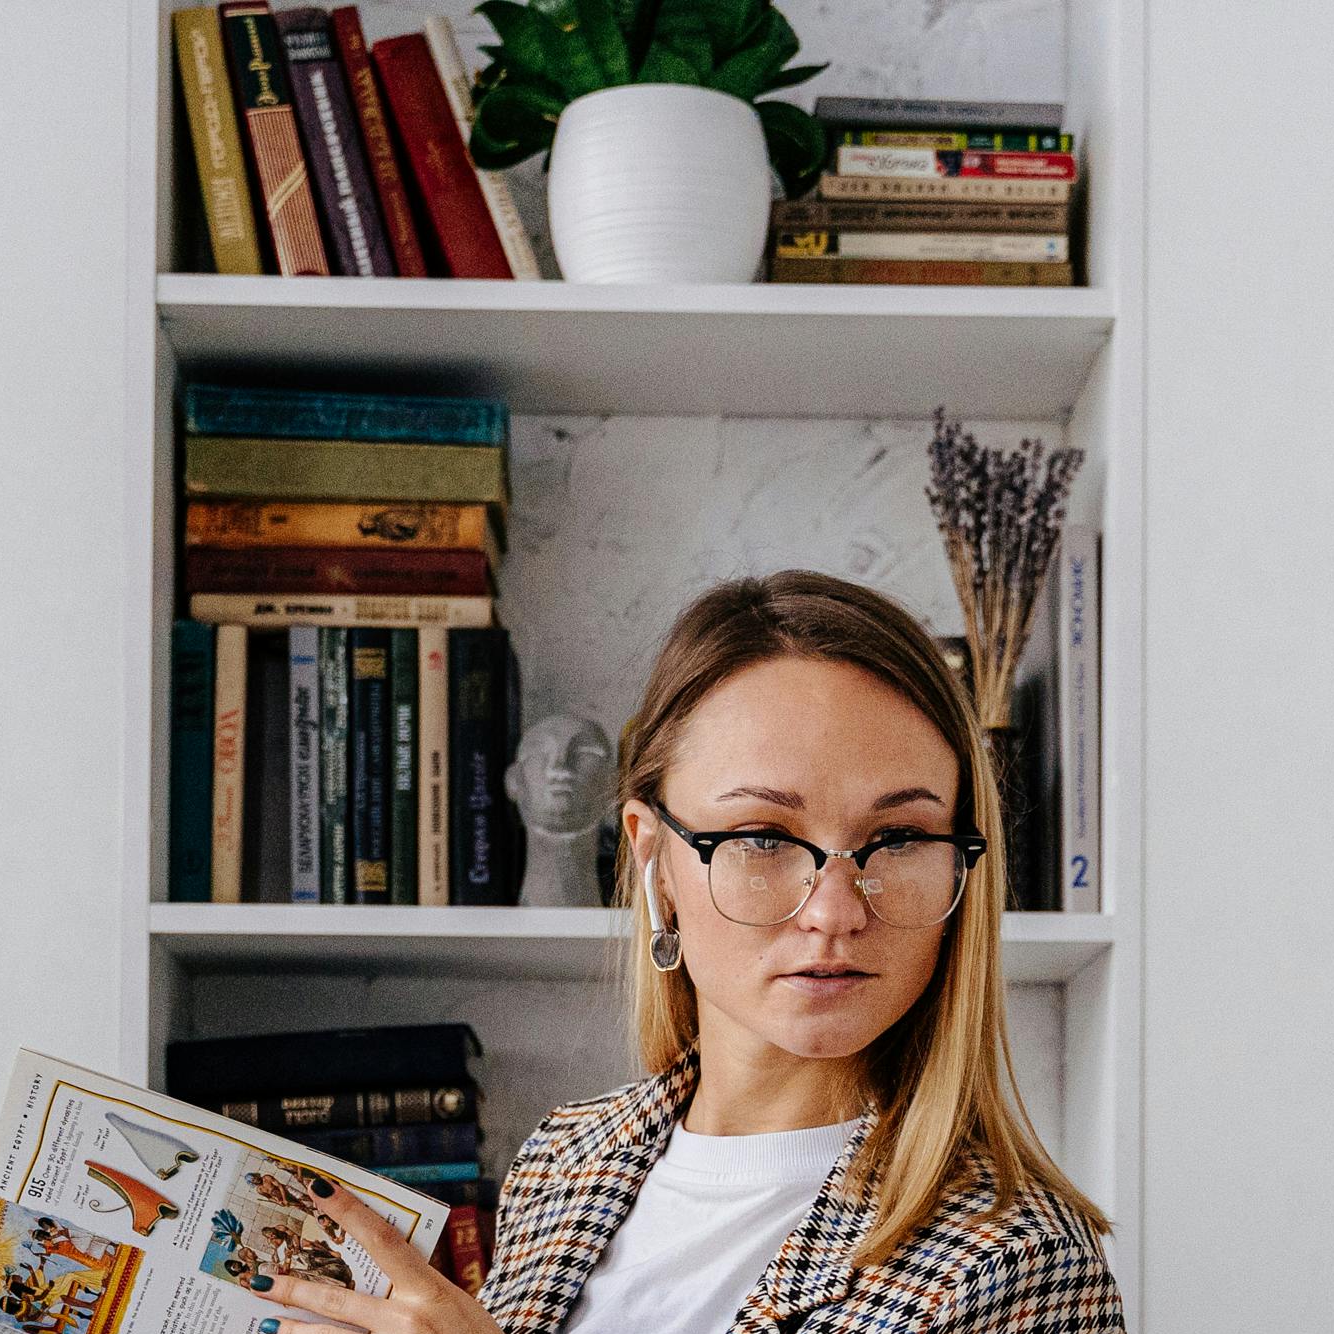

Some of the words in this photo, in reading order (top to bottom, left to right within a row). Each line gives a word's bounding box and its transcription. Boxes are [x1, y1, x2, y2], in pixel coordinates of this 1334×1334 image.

[1071, 855, 1088, 888] 2
[12, 1123, 27, 1150] EGYPT
[25, 1072, 43, 1109] HISTORY
[59, 1097, 76, 1126] dynasties
[49, 1125, 65, 1153] different
[46, 1152, 56, 1163] 30
[41, 1163, 52, 1178] Over
[43, 1186, 54, 1203] ruled
[49, 1165, 61, 1187] ancient
[55, 1146, 69, 1165] Egypt.
[27, 1176, 47, 1199] 915
[184, 1286, 192, 1295] as
[187, 1276, 195, 1286] his
[164, 1299, 176, 1318] often
[172, 1276, 186, 1299] married
[178, 1294, 189, 1310] such
